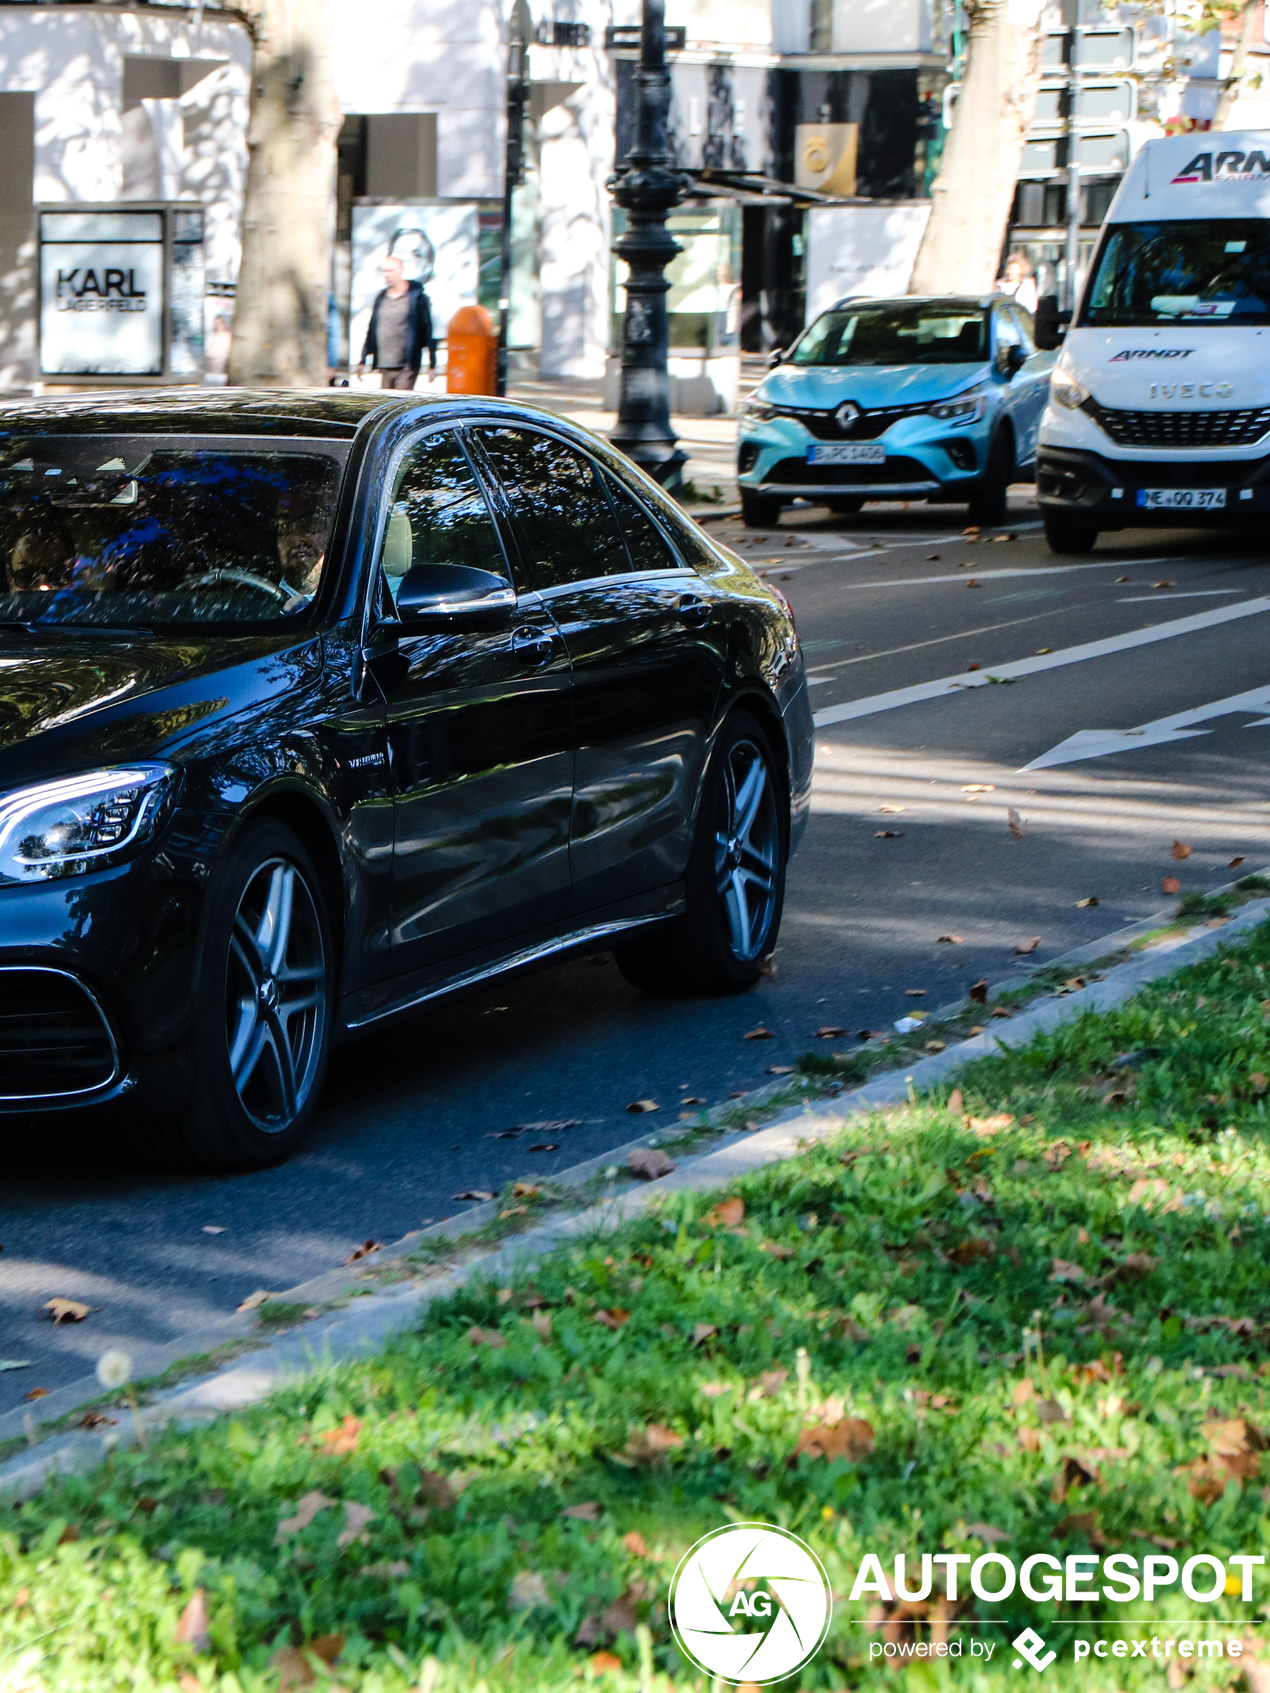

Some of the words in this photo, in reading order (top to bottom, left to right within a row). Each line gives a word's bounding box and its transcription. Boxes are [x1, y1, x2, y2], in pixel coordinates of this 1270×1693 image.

[56, 269, 146, 297] KARL
[56, 300, 147, 312] LAGERFELD
[1108, 350, 1197, 362] ARNDT
[1148, 382, 1233, 399] IVECO
